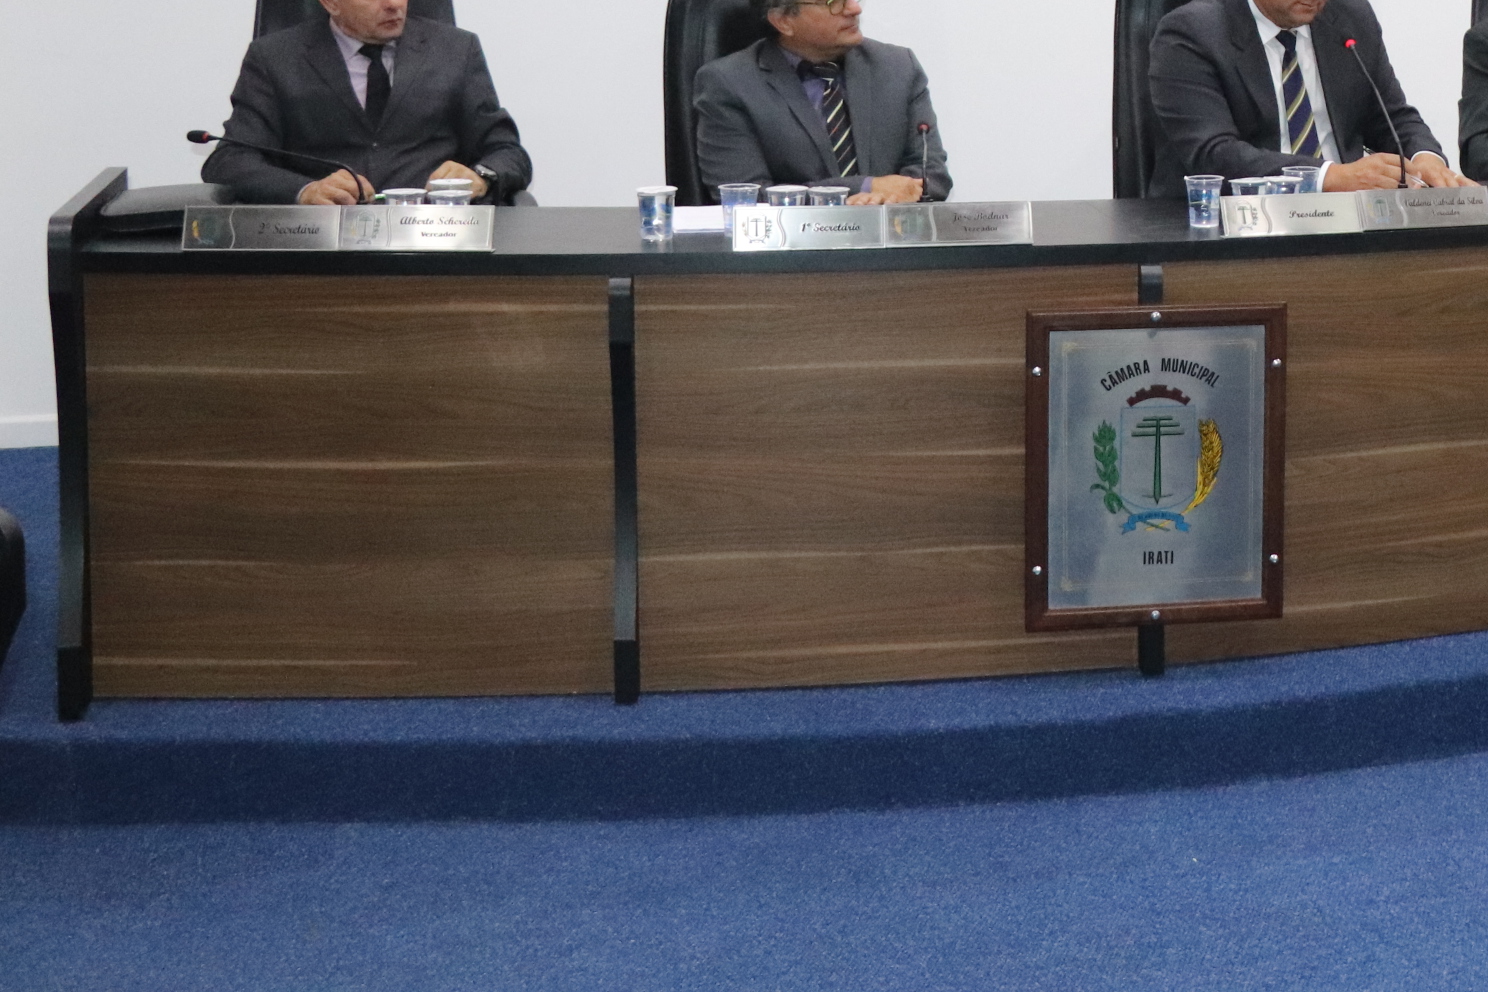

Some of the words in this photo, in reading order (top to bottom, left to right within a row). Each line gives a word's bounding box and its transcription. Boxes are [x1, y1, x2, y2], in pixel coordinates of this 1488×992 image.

[1289, 209, 1335, 218] Presidente
[400, 216, 435, 225] Alberto
[272, 223, 320, 235] Secretário
[813, 222, 860, 232] Secretário
[1100, 359, 1151, 392] CÂMARA
[1160, 357, 1220, 388] MUNICIPAL
[1143, 550, 1174, 565] IRATI
